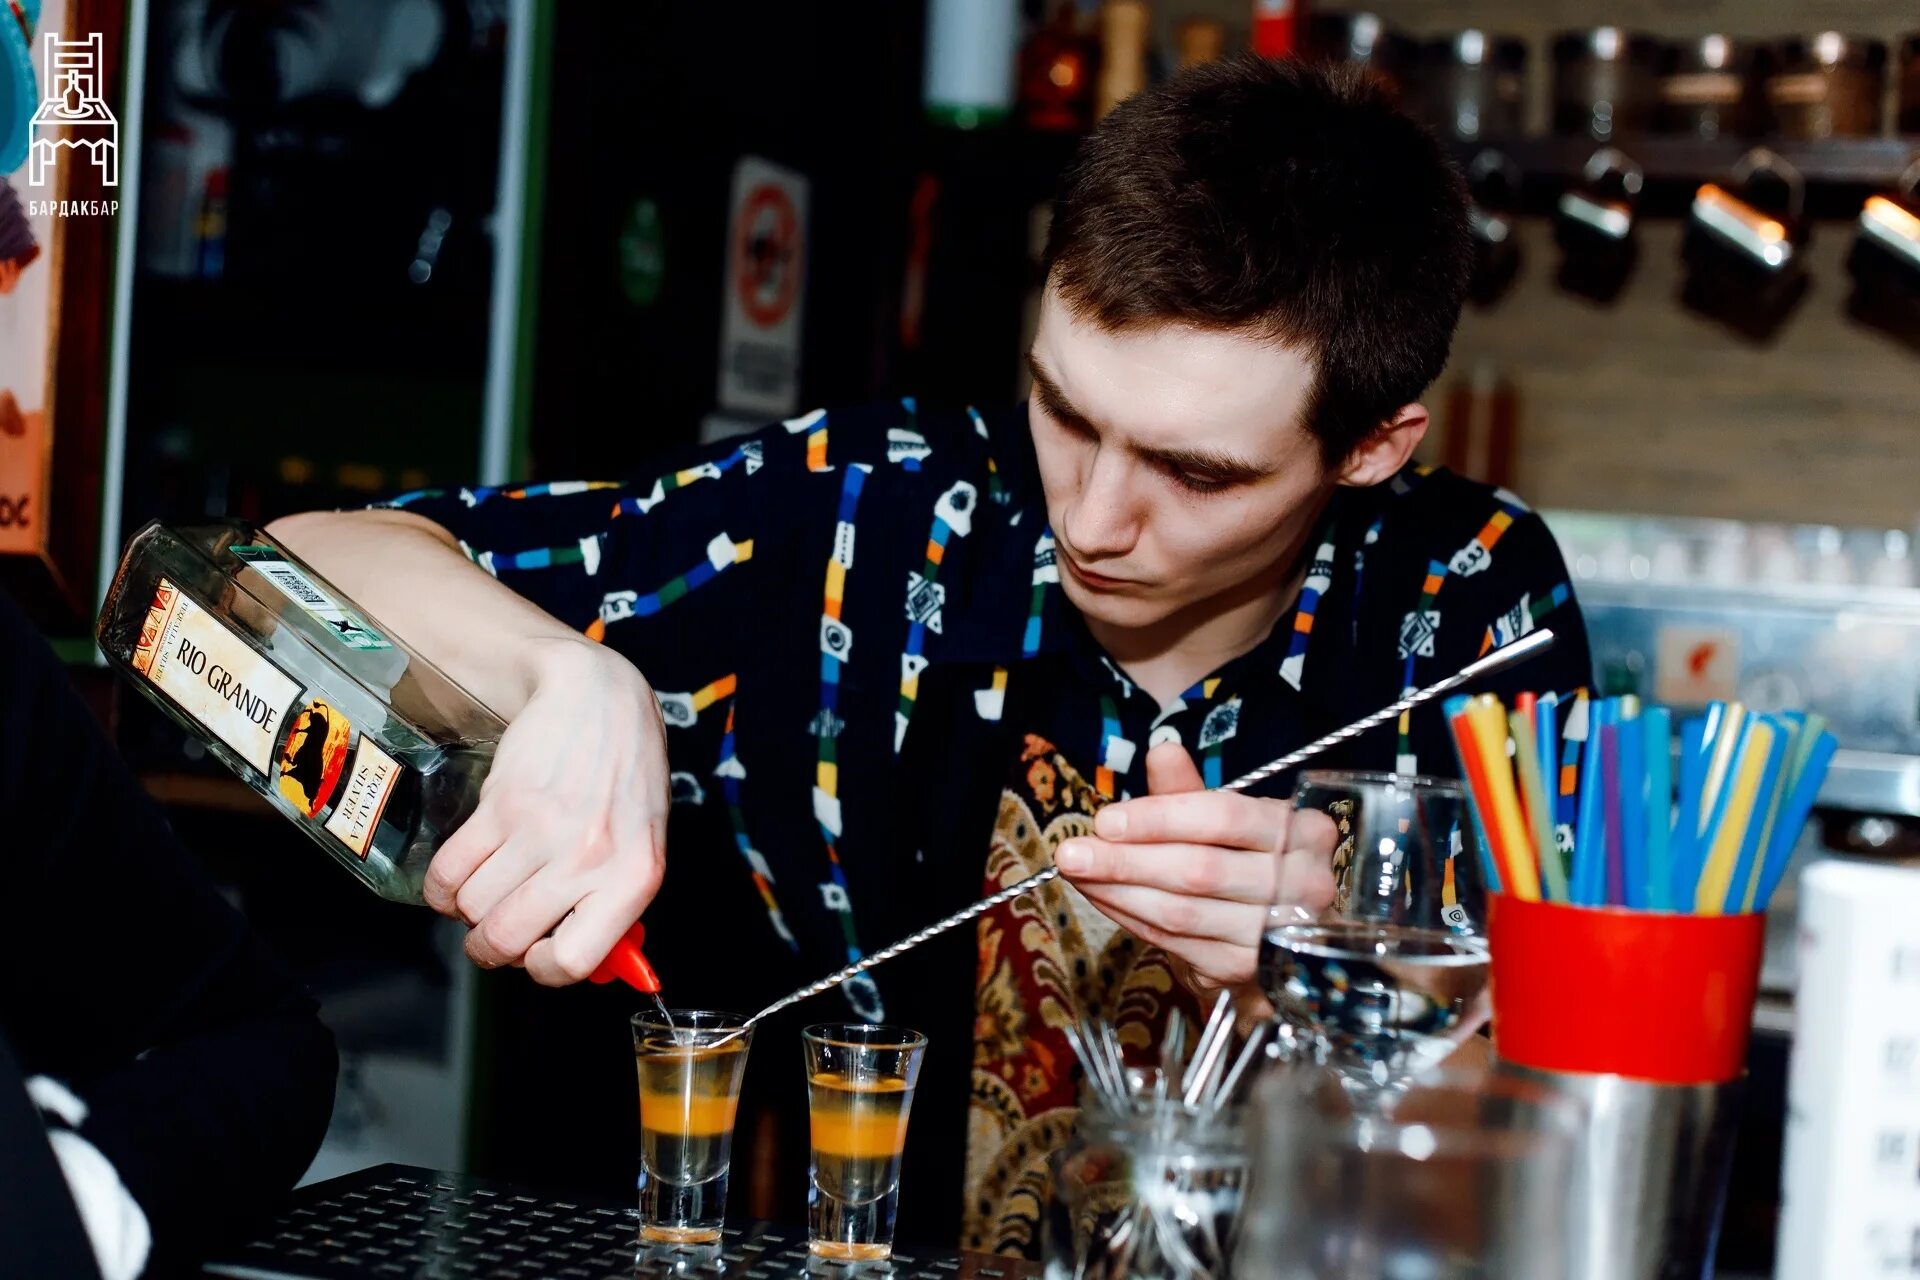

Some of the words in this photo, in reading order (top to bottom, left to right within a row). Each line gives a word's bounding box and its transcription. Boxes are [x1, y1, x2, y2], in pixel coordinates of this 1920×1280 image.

[155, 651, 169, 683] SILVER
[176, 637, 207, 675] RIO
[207, 665, 277, 734] GRANDE
[342, 765, 369, 820] SILVER
